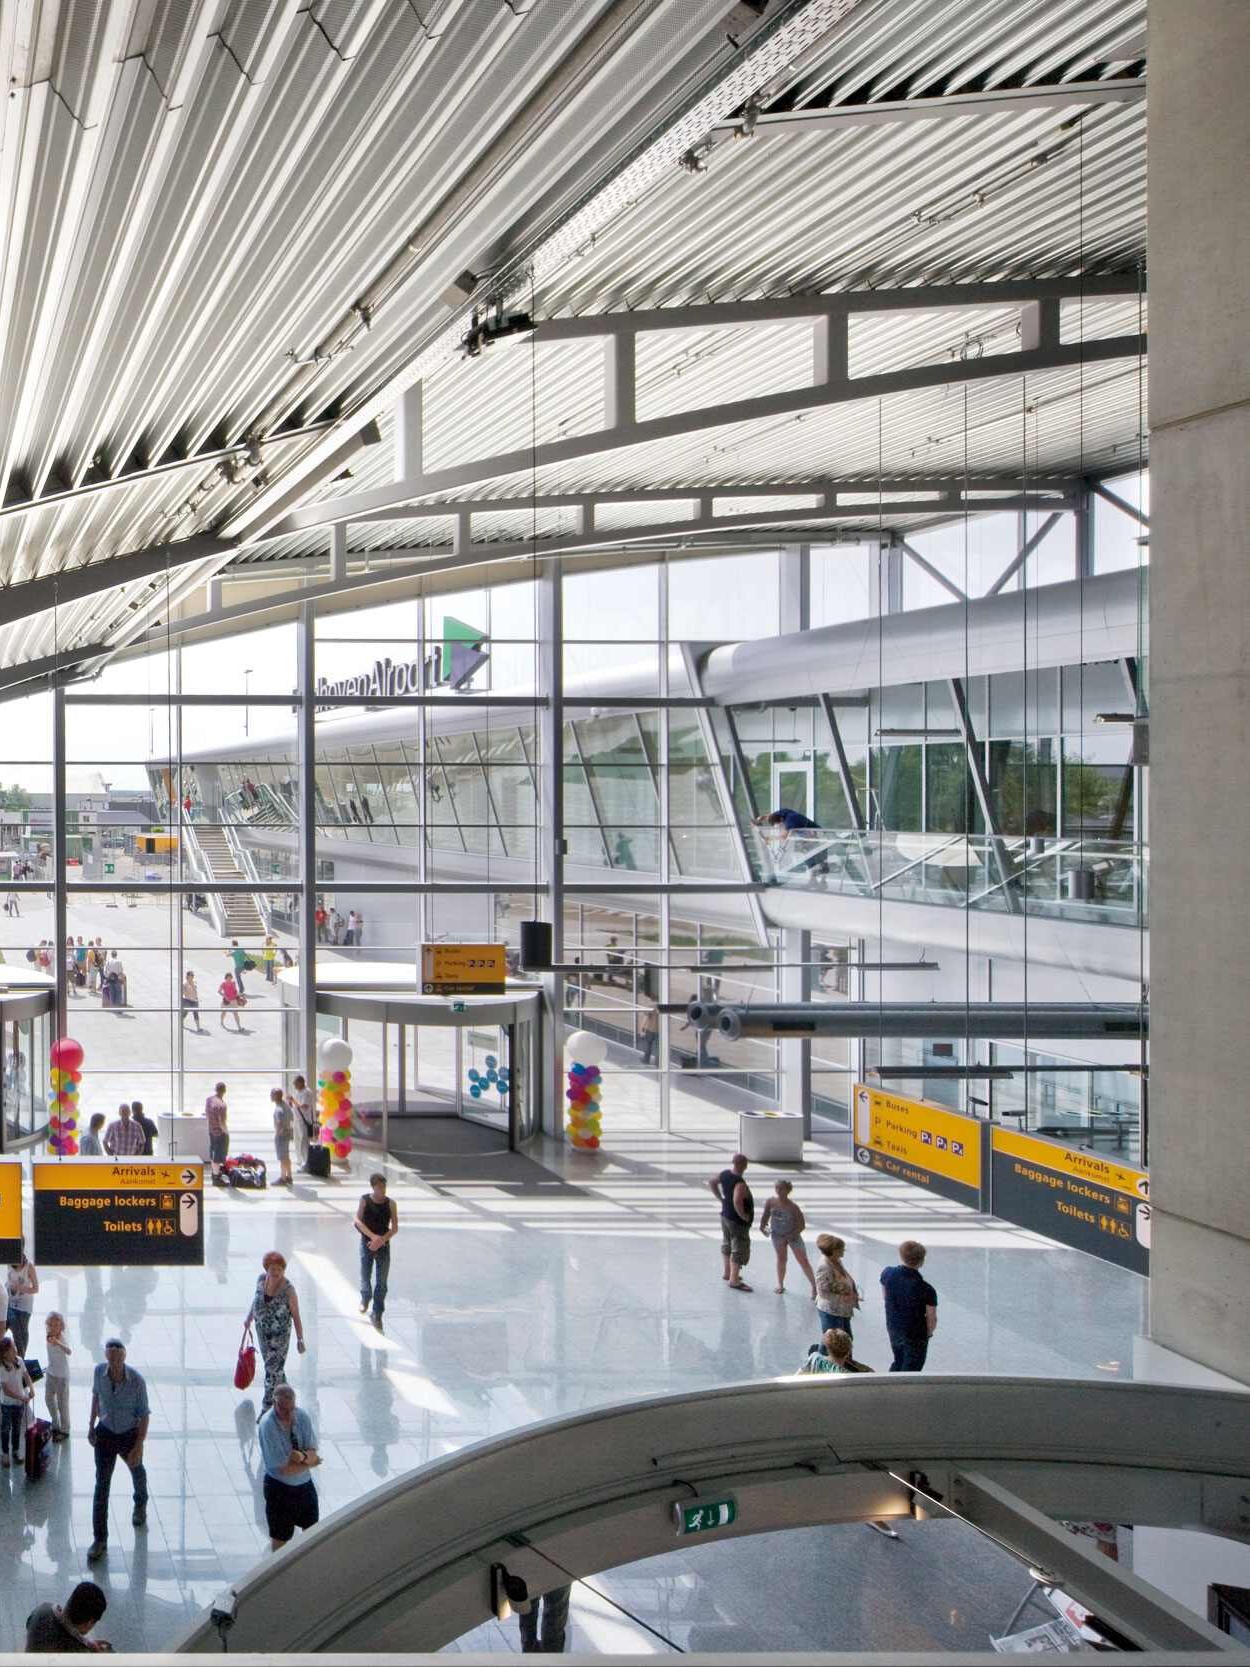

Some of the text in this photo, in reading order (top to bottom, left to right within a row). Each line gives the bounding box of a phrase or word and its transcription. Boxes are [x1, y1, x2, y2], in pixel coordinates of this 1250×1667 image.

[885, 1100, 910, 1114] Buses
[886, 1120, 918, 1139] Parking
[112, 1166, 156, 1176] Arrivals
[1065, 1152, 1110, 1173] Arrivals
[886, 1161, 930, 1184] Car rental
[1014, 1163, 1064, 1188] Baggage
[1067, 1181, 1110, 1204] lockers
[59, 1195, 157, 1208] Baggage lockers
[1055, 1201, 1095, 1223] Toilets
[104, 1221, 143, 1232] Toilets
